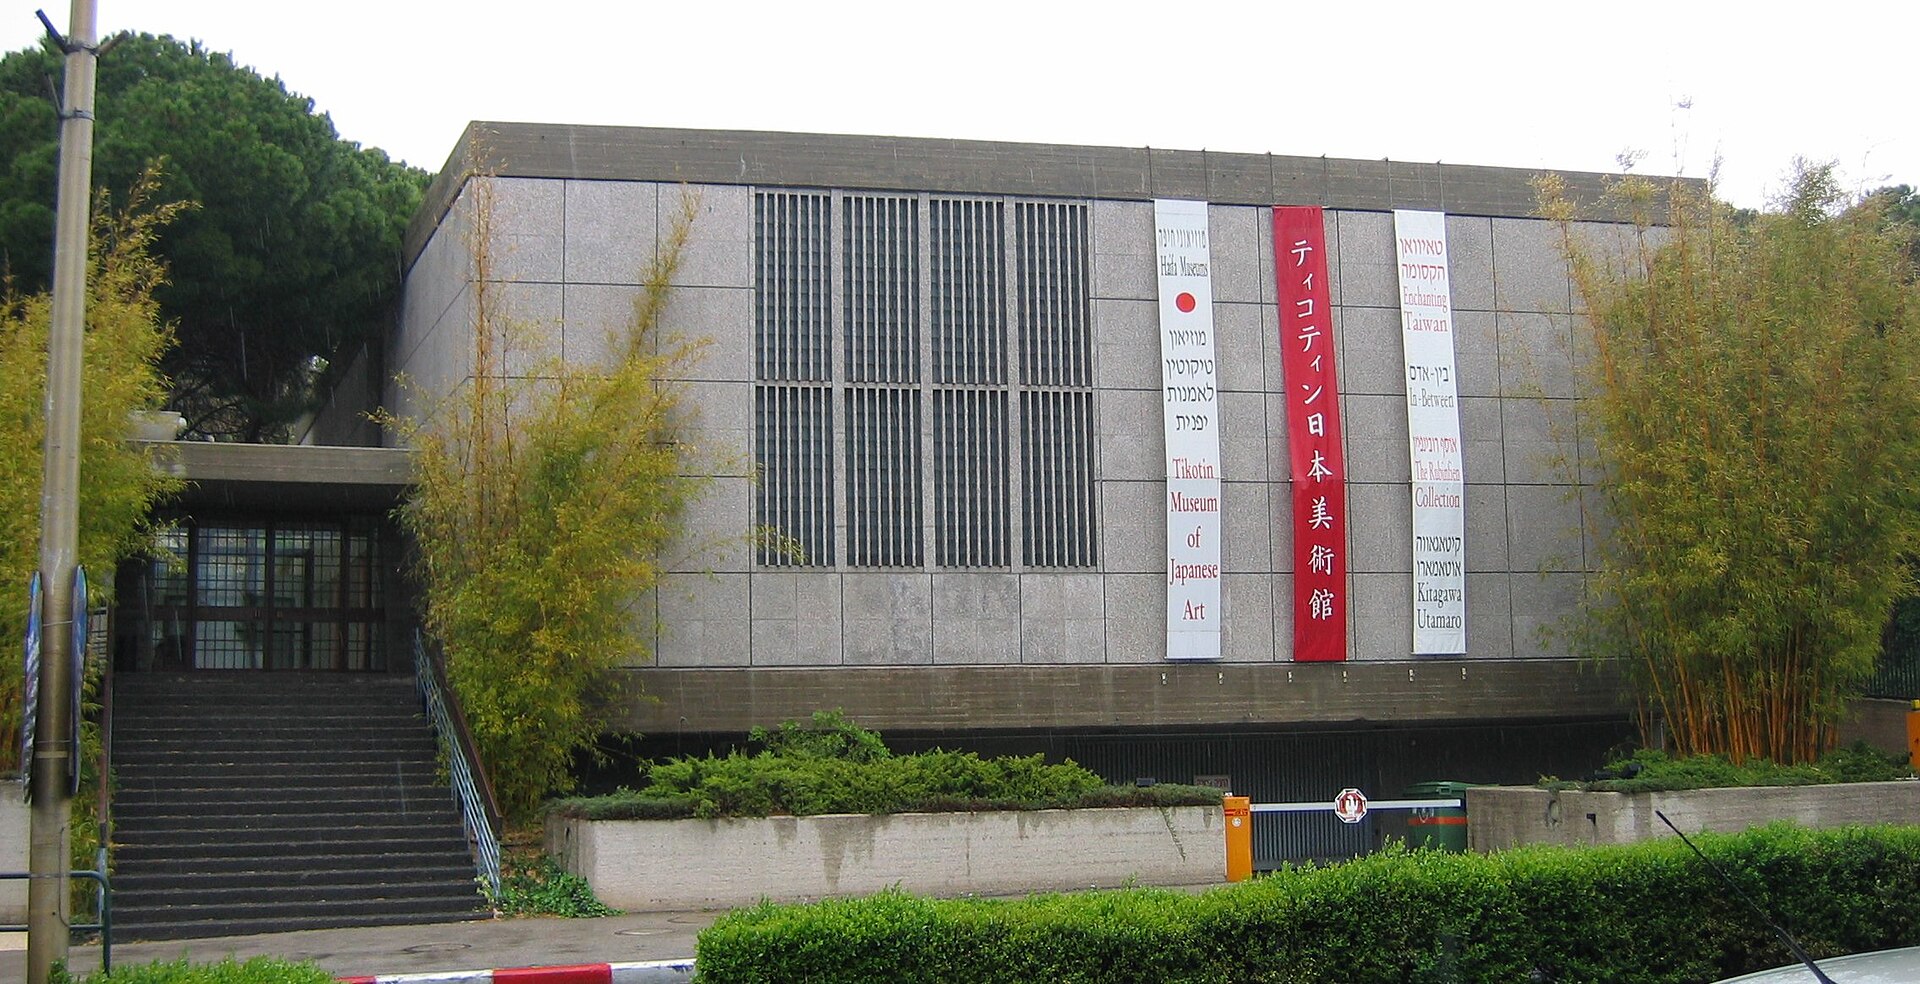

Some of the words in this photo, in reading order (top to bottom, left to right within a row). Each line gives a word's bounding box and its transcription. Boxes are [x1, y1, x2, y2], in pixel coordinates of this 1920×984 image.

[1400, 238, 1444, 259] טאיוואן
[1402, 263, 1446, 285] הקסומה
[1403, 286, 1449, 313] Enchanting
[1404, 311, 1449, 332] Taiwan
[1169, 329, 1207, 351] מוזיאון
[1166, 359, 1214, 380] טיקוטין
[1167, 382, 1215, 402] לאמנות
[1176, 415, 1208, 431] יפנית
[1291, 239, 1335, 621] ティコティン日本美術館
[1173, 458, 1214, 480] Tikotin
[1170, 491, 1218, 513] Museum
[1415, 486, 1460, 508] Collection
[1187, 525, 1201, 548] of
[1170, 558, 1218, 585] Japanese
[1417, 582, 1462, 608] Kitagawa
[1183, 599, 1205, 620] Art
[1417, 608, 1462, 629] Utamaro
